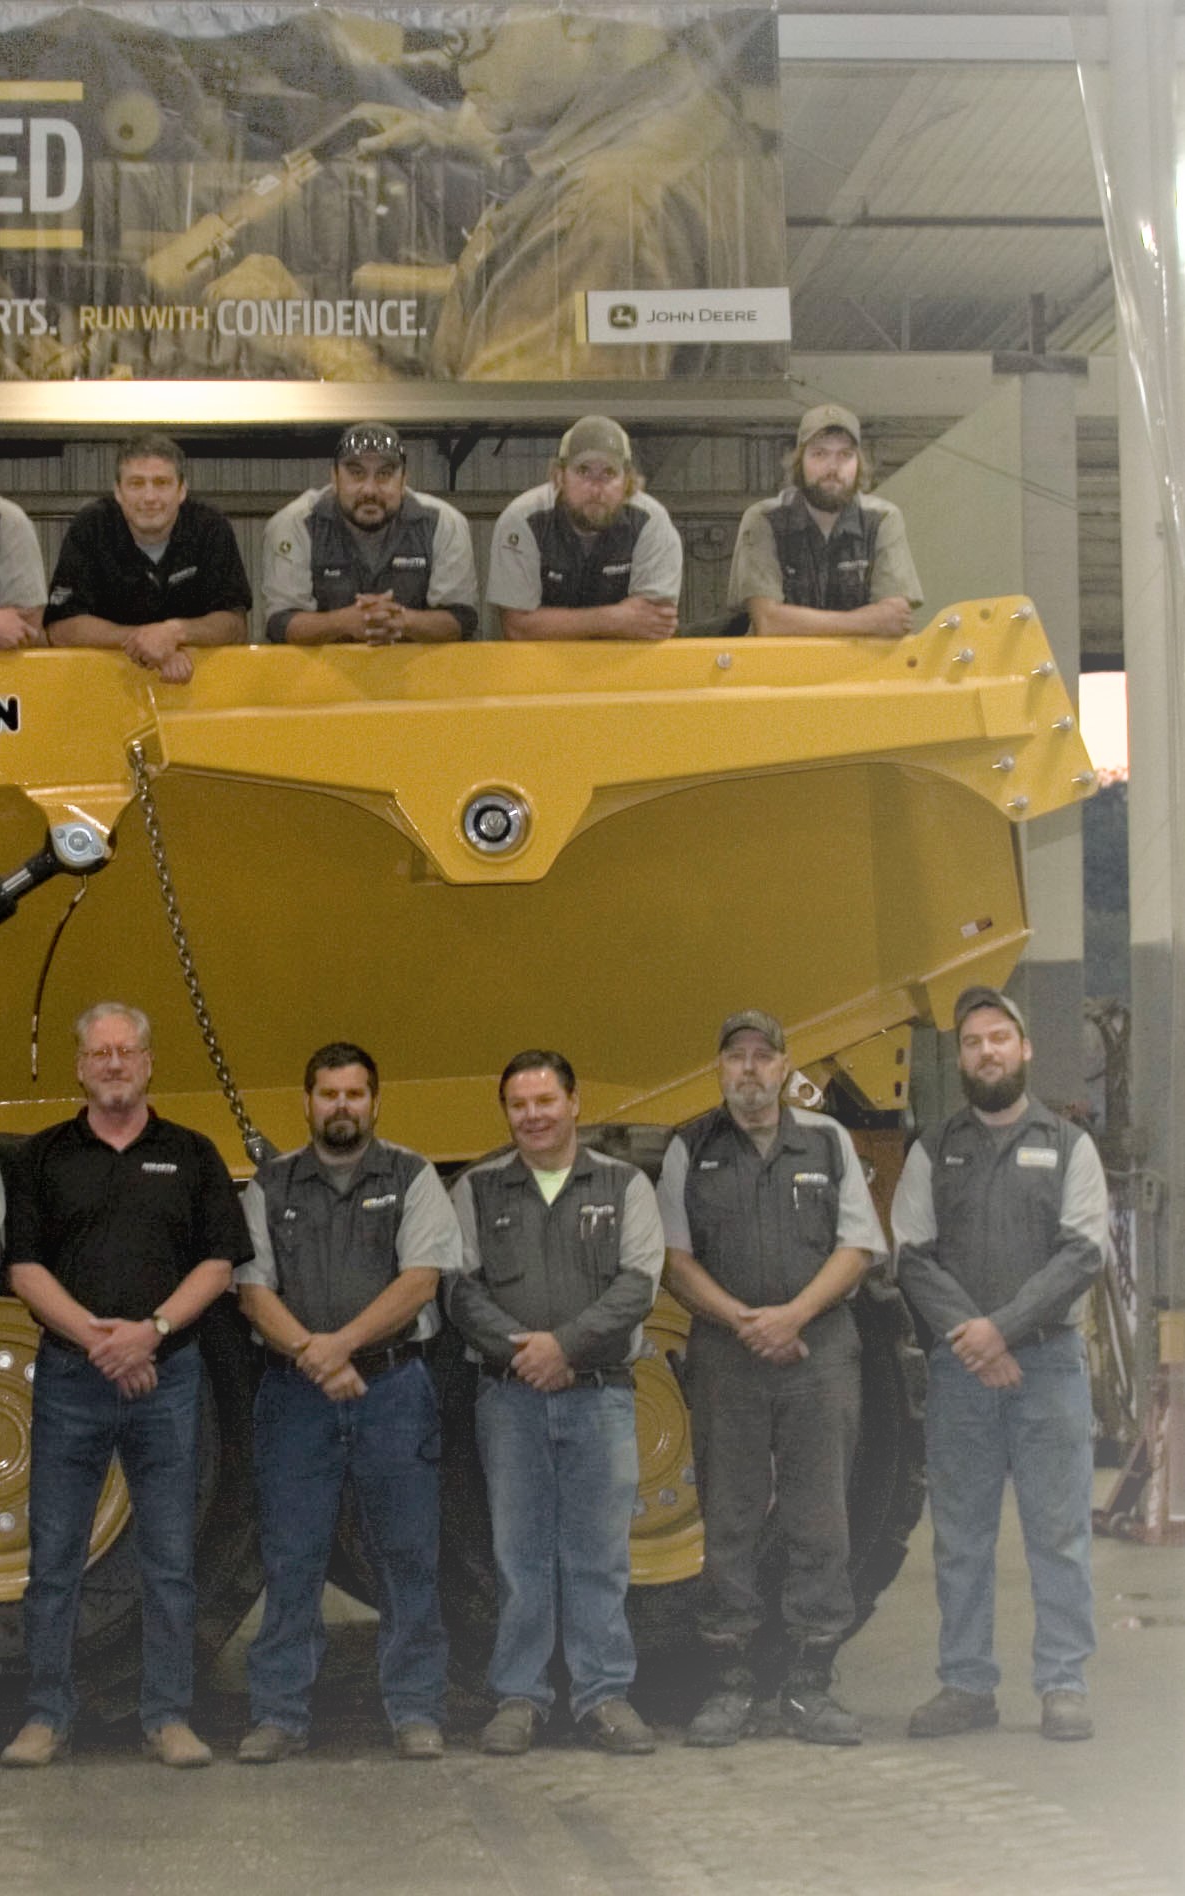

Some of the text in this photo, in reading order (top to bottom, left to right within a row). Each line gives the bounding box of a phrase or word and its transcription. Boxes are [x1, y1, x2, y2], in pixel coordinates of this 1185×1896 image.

[79, 305, 135, 330] RUN
[141, 304, 209, 330] WITH
[217, 299, 427, 337] CONFIDENCE.
[646, 309, 758, 323] JOHN DEERE
